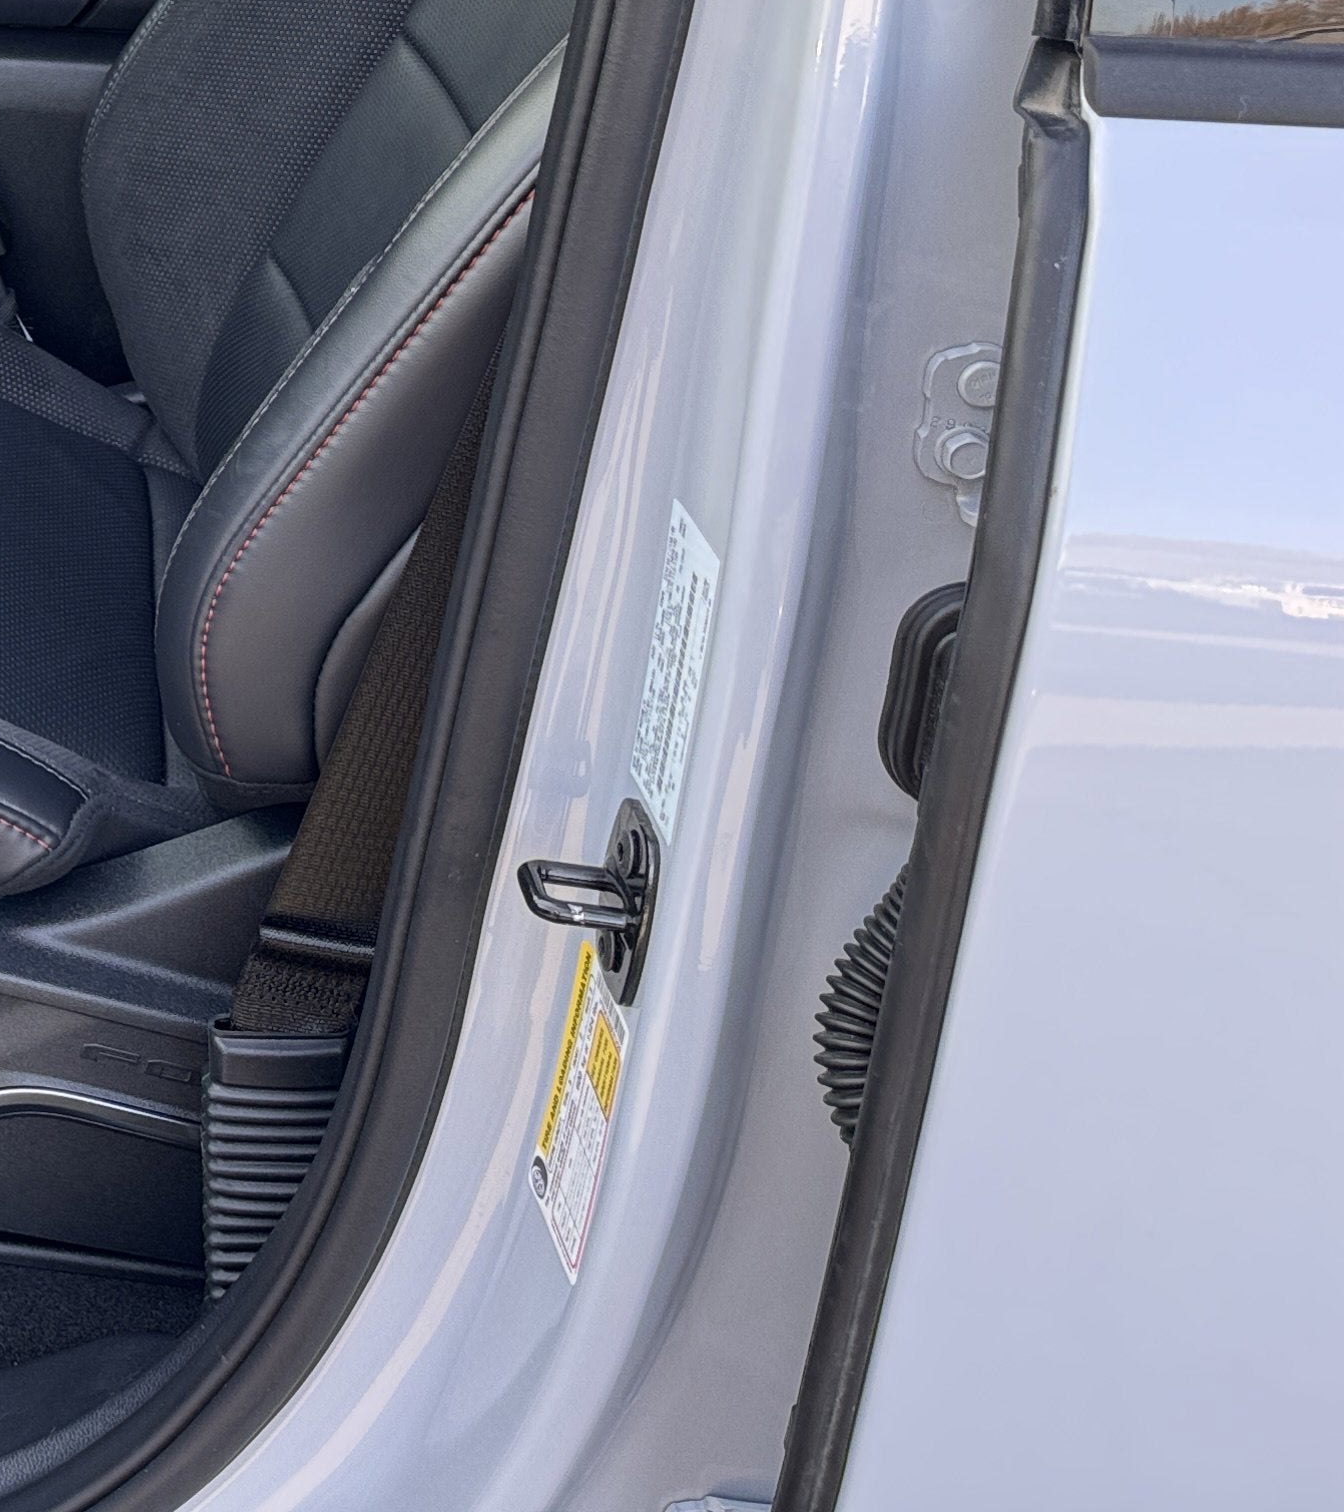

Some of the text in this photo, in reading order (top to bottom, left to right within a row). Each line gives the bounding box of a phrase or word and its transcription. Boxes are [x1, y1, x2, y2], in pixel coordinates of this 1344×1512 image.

[541, 951, 592, 1151] TIRE AND LOADING INFORMATION
